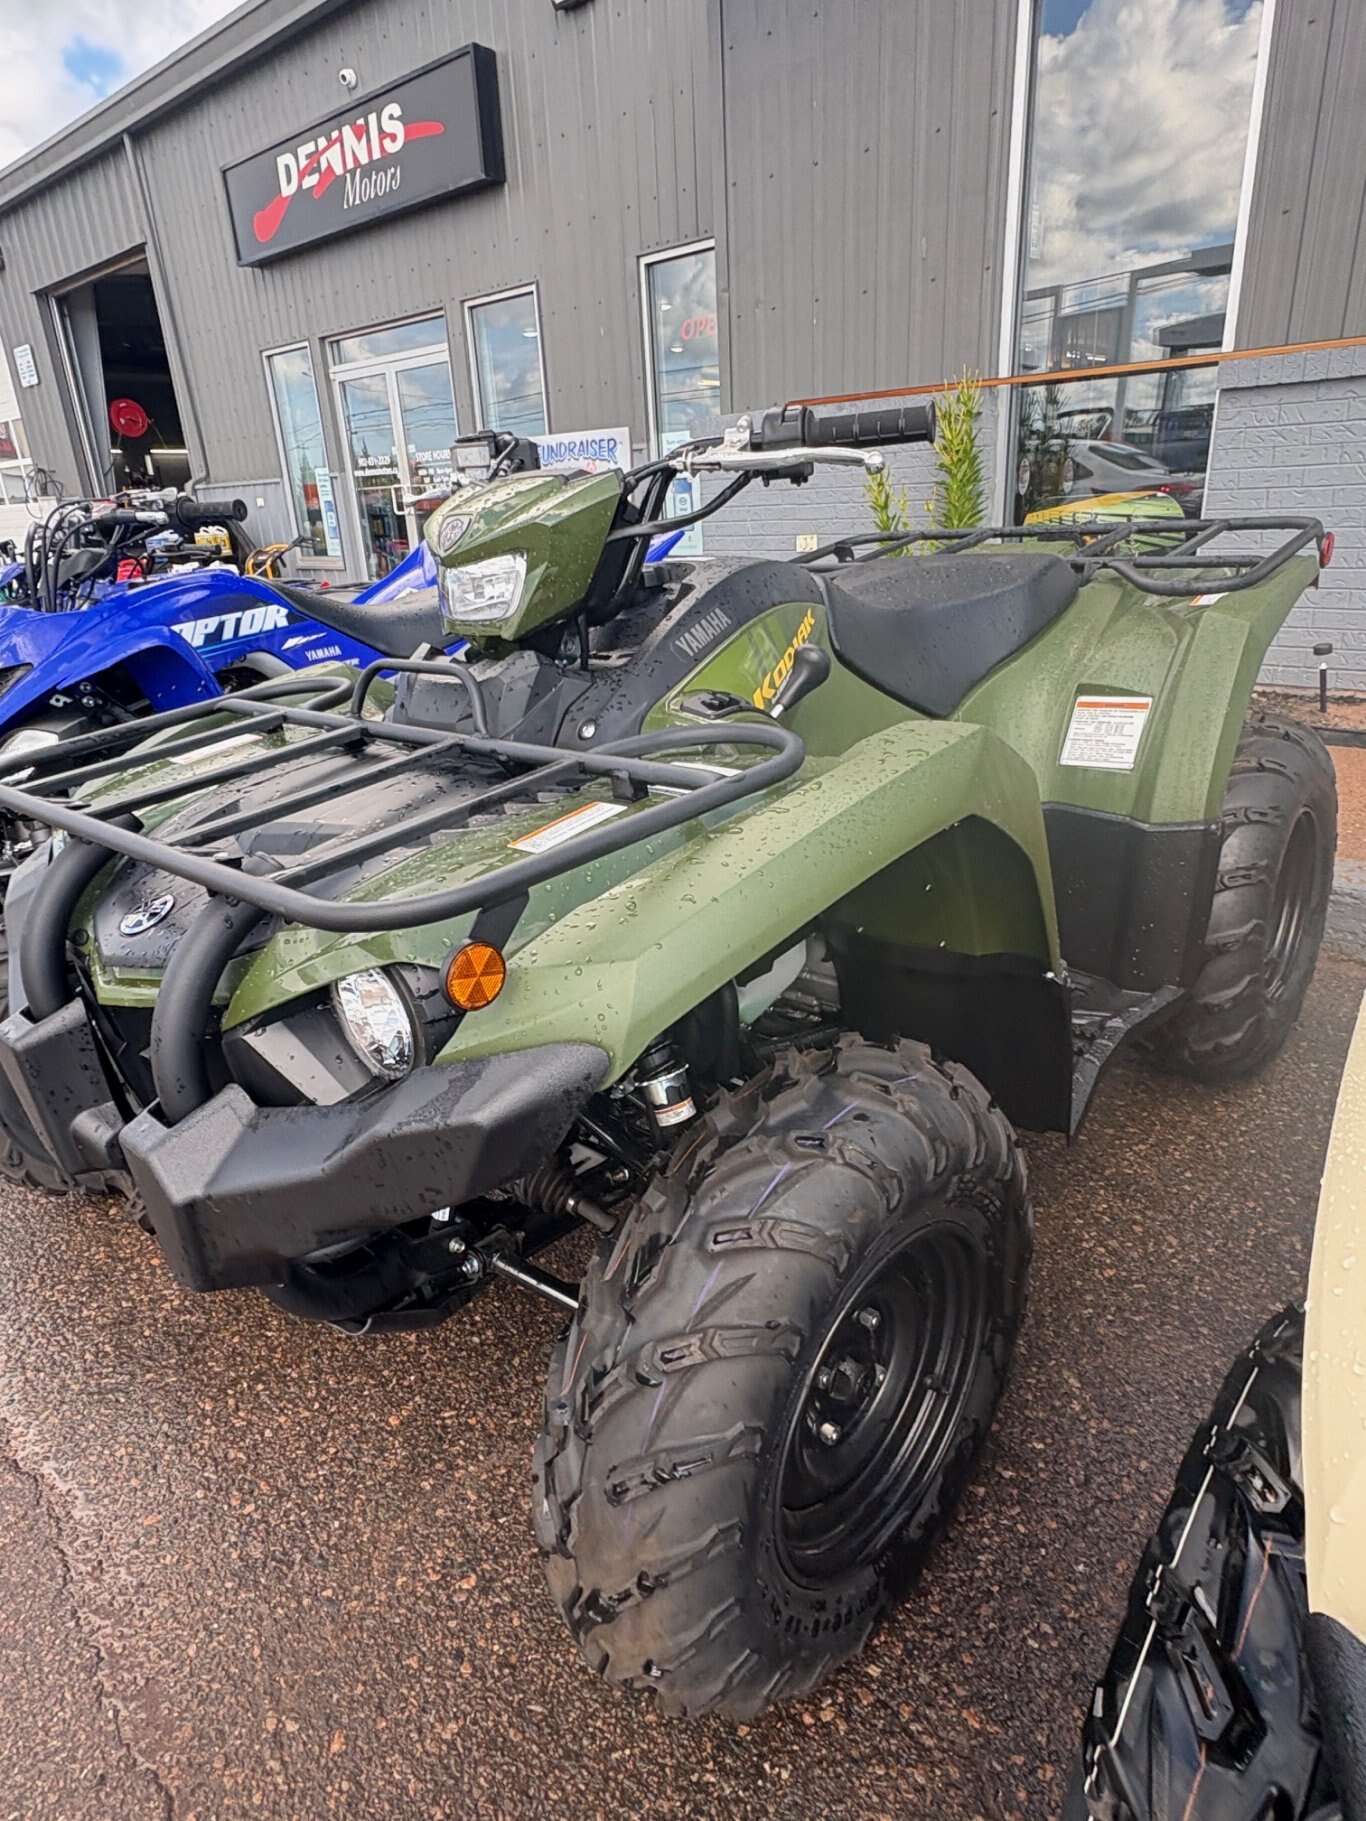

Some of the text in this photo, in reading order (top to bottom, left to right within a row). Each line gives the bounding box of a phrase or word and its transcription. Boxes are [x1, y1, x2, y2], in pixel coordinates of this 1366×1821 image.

[276, 103, 405, 198] DENNIS
[343, 165, 401, 209] Motors
[680, 315, 716, 341] OPE
[415, 451, 432, 462] STORE
[170, 604, 289, 648] APTOR
[675, 607, 732, 657] YAMAHA
[304, 645, 343, 662] YAMAHA
[753, 608, 816, 710] KODIAK
